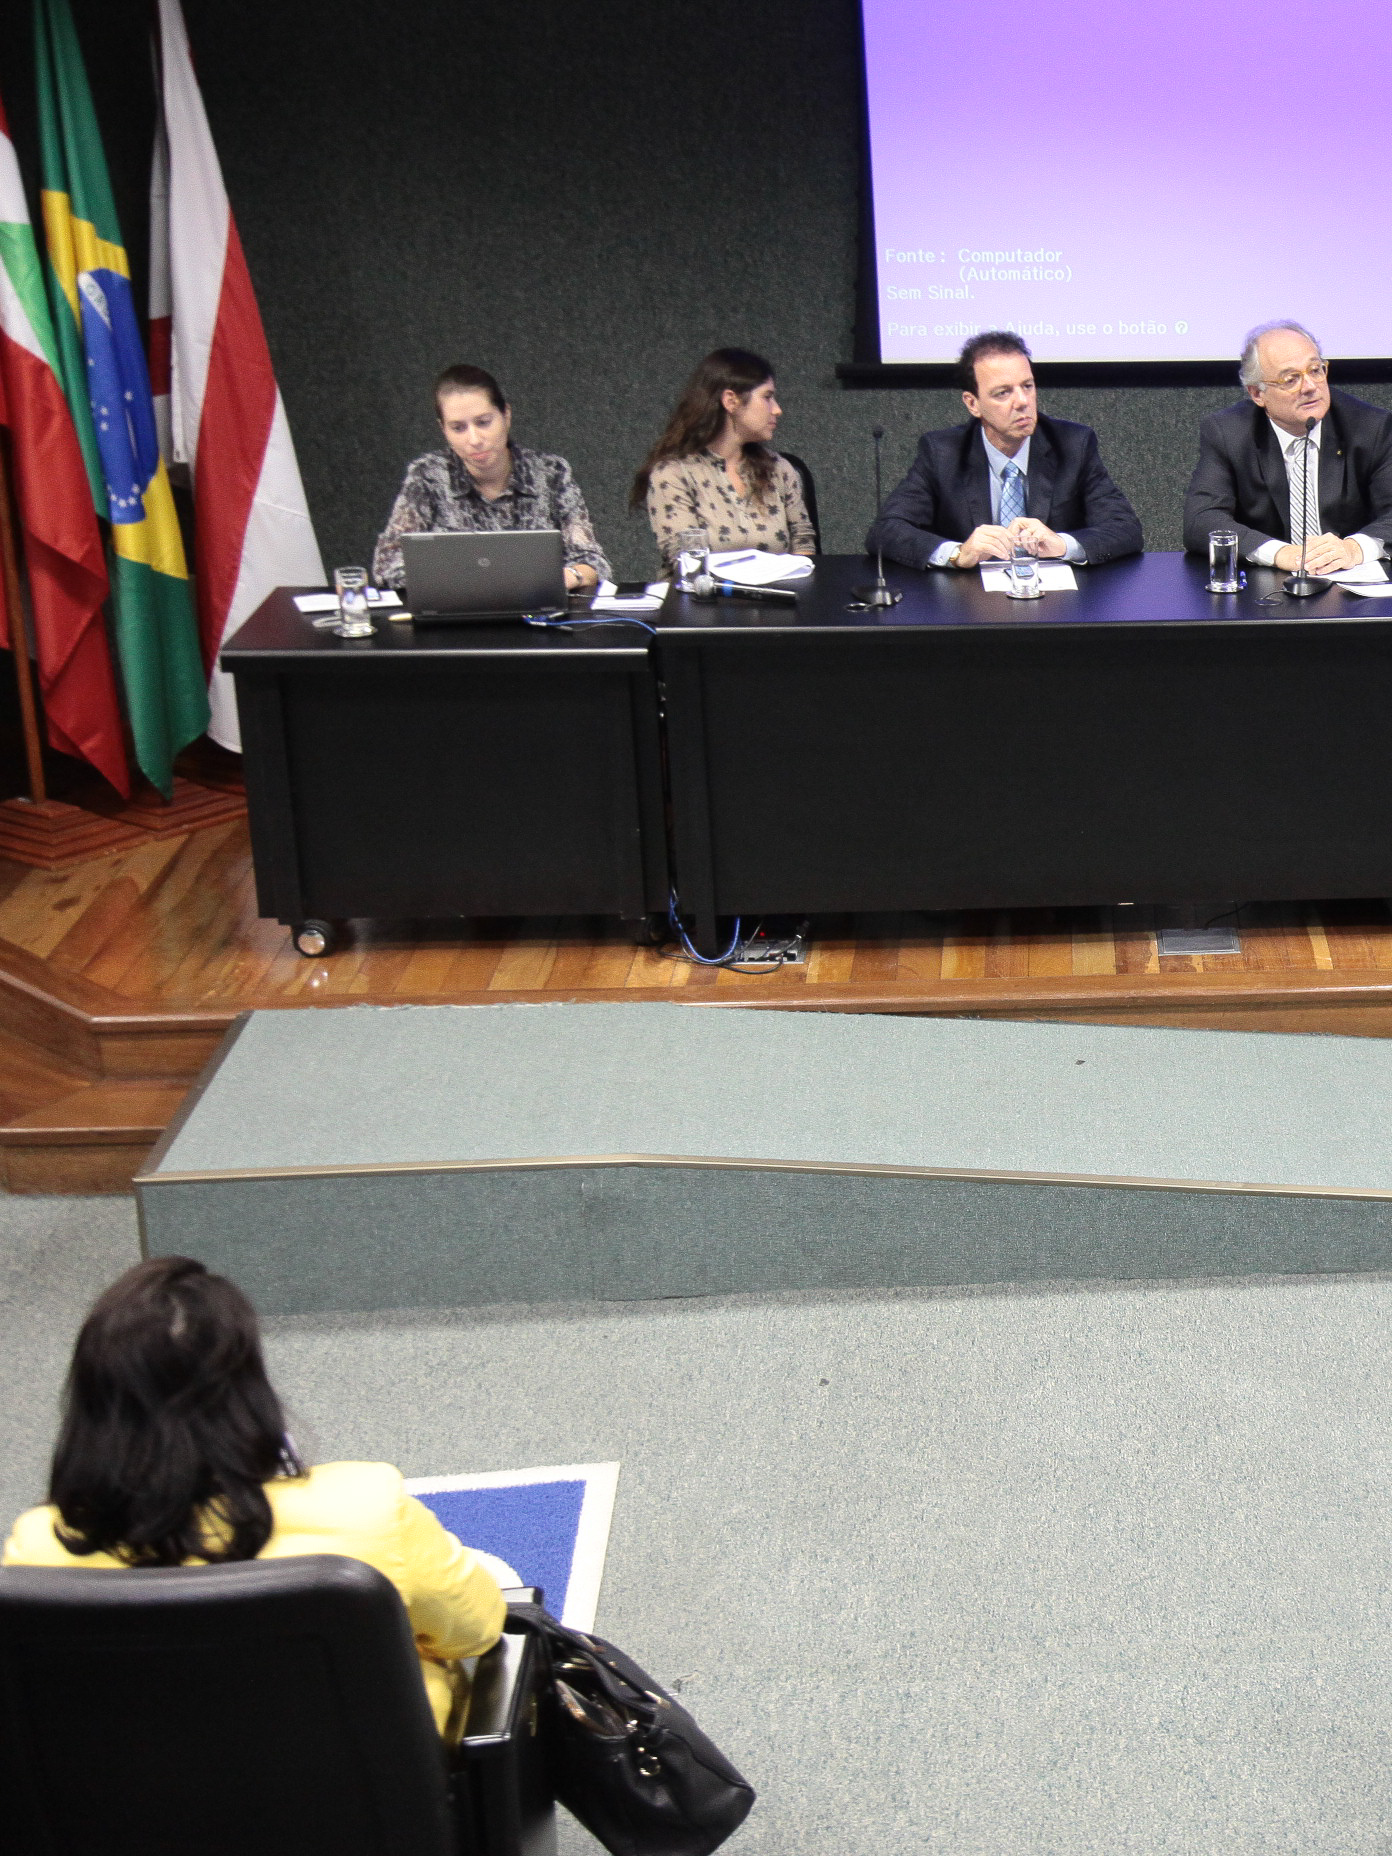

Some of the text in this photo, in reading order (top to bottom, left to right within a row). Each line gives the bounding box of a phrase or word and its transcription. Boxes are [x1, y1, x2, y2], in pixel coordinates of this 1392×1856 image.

[958, 247, 1063, 264] Computador
[959, 265, 1072, 282] (Automático)
[887, 284, 975, 300] Sem Sinal.
[888, 322, 928, 336] Para
[934, 321, 982, 336] exibir
[1006, 321, 1060, 336] Ajuda,
[1066, 322, 1097, 334] use
[1103, 322, 1113, 334] o
[1119, 319, 1168, 334] botão
